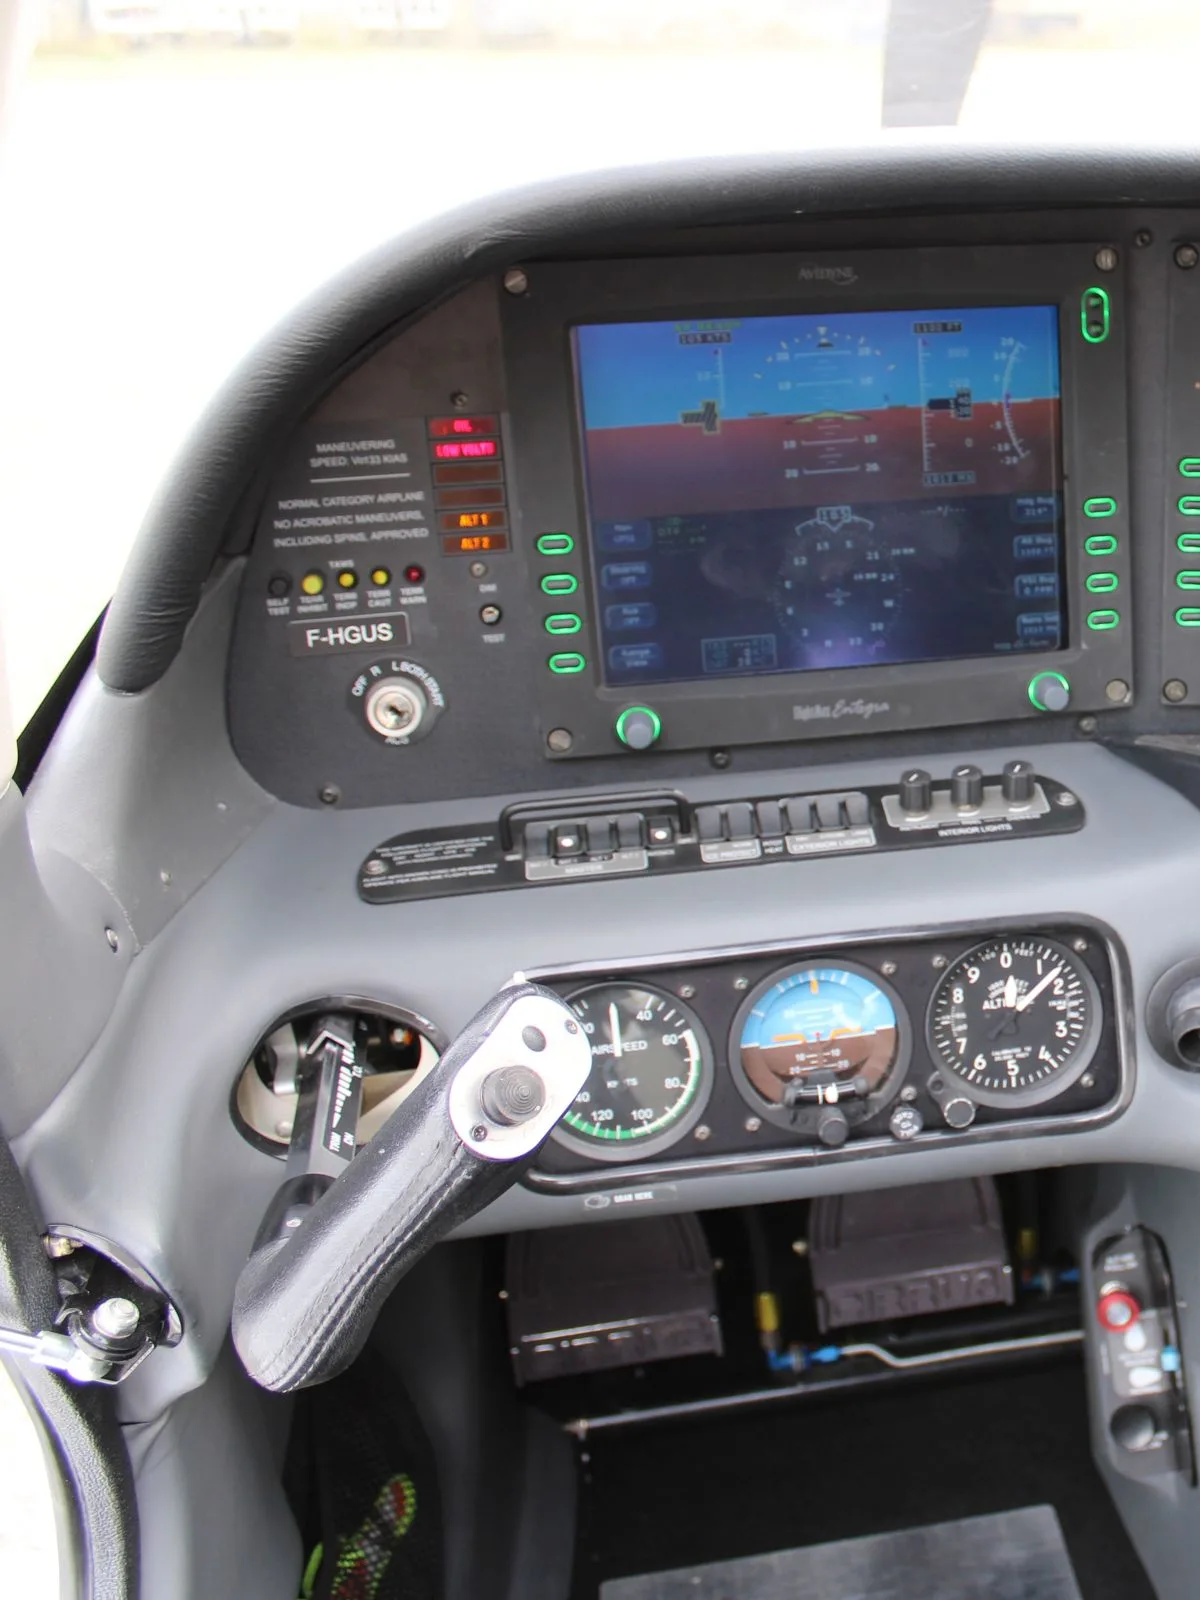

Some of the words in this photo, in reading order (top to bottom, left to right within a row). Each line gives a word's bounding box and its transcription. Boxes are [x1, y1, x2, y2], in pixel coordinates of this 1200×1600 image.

[306, 623, 392, 648] F-HGUS
[1000, 951, 1012, 968] 0
[1036, 959, 1042, 976] 1
[967, 966, 980, 984] 9
[1054, 978, 1064, 995] 2
[952, 988, 964, 1004] 8
[636, 1010, 652, 1020] 40
[1055, 1021, 1068, 1038] 3
[662, 1034, 679, 1046] 60
[956, 1038, 968, 1055] 7
[1038, 1045, 1052, 1060] 4
[974, 1054, 987, 1071] 6
[1006, 1060, 1020, 1076] 5
[664, 1077, 680, 1089] 80
[590, 1109, 614, 1121] 120
[631, 1109, 654, 1120] 100
